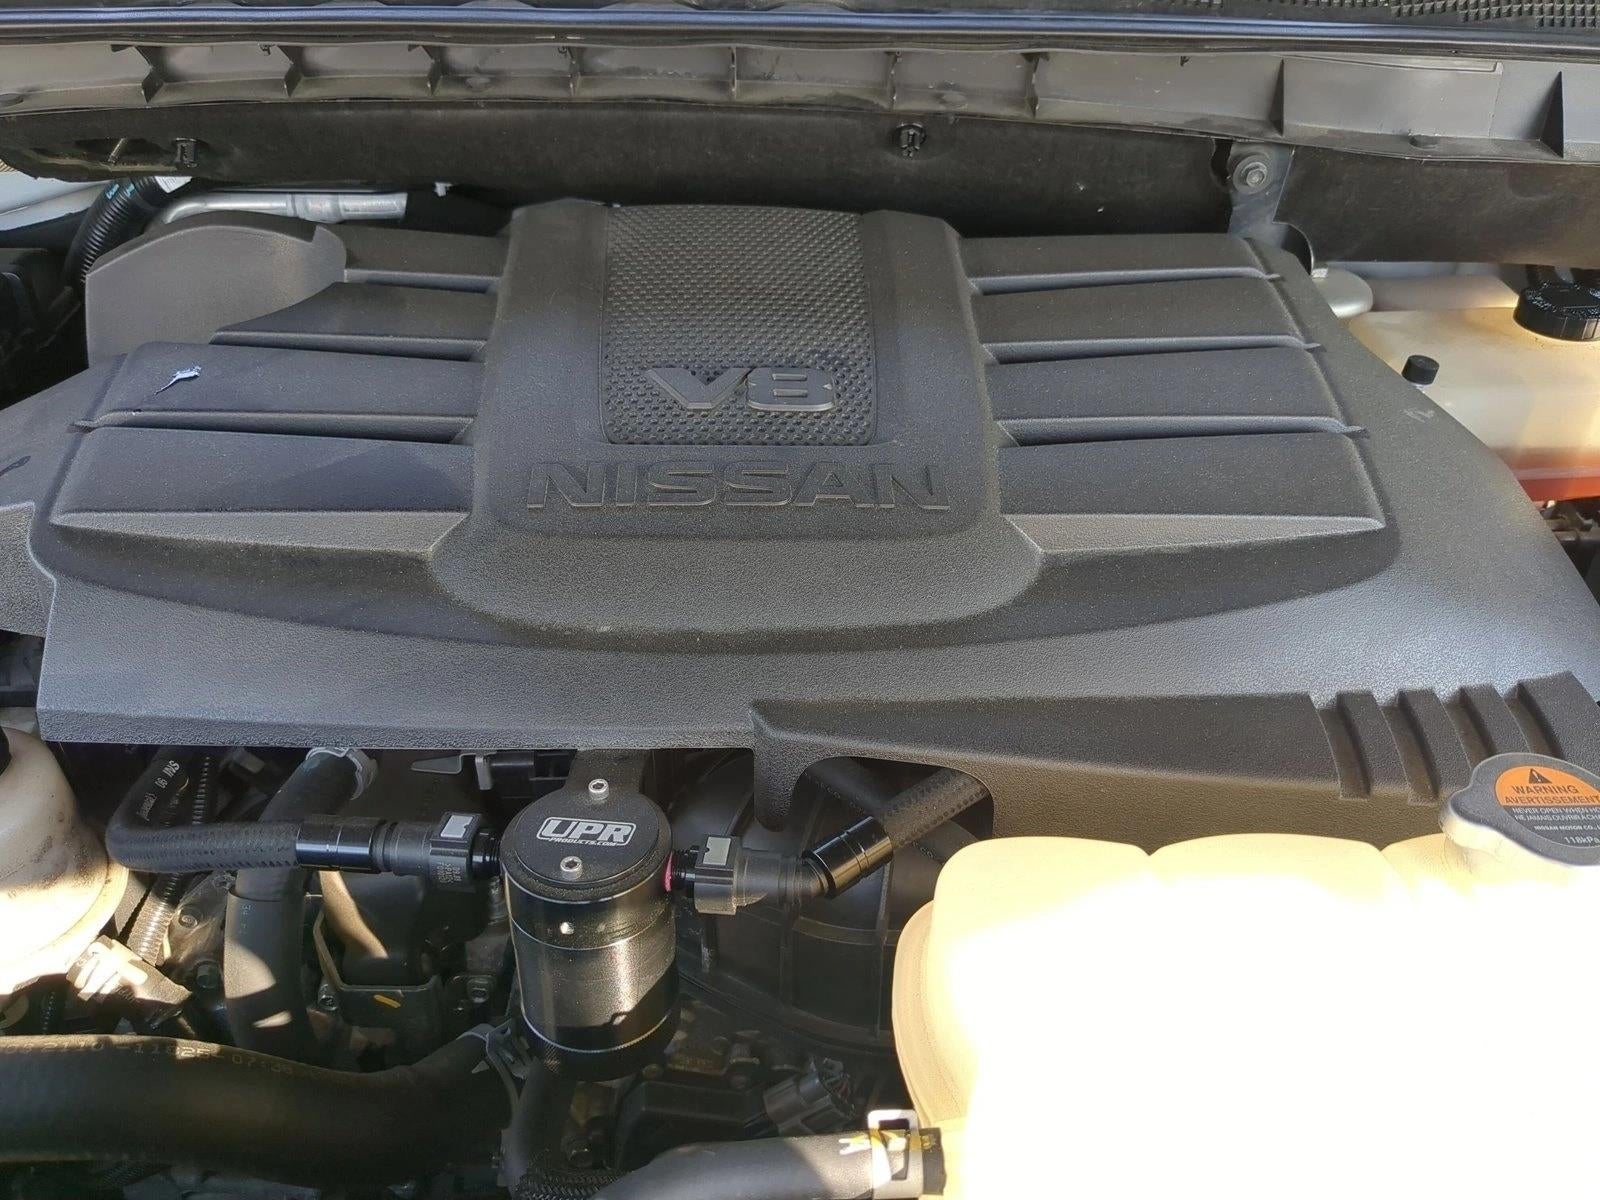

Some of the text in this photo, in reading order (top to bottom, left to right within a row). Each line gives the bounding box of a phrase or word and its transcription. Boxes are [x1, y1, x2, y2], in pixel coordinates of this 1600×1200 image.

[647, 366, 836, 413] V8
[525, 460, 951, 510] NISSAN
[1504, 795, 1600, 804] AVERTISSEMENT
[1511, 784, 1580, 794] WARNING
[541, 819, 632, 843] UPR
